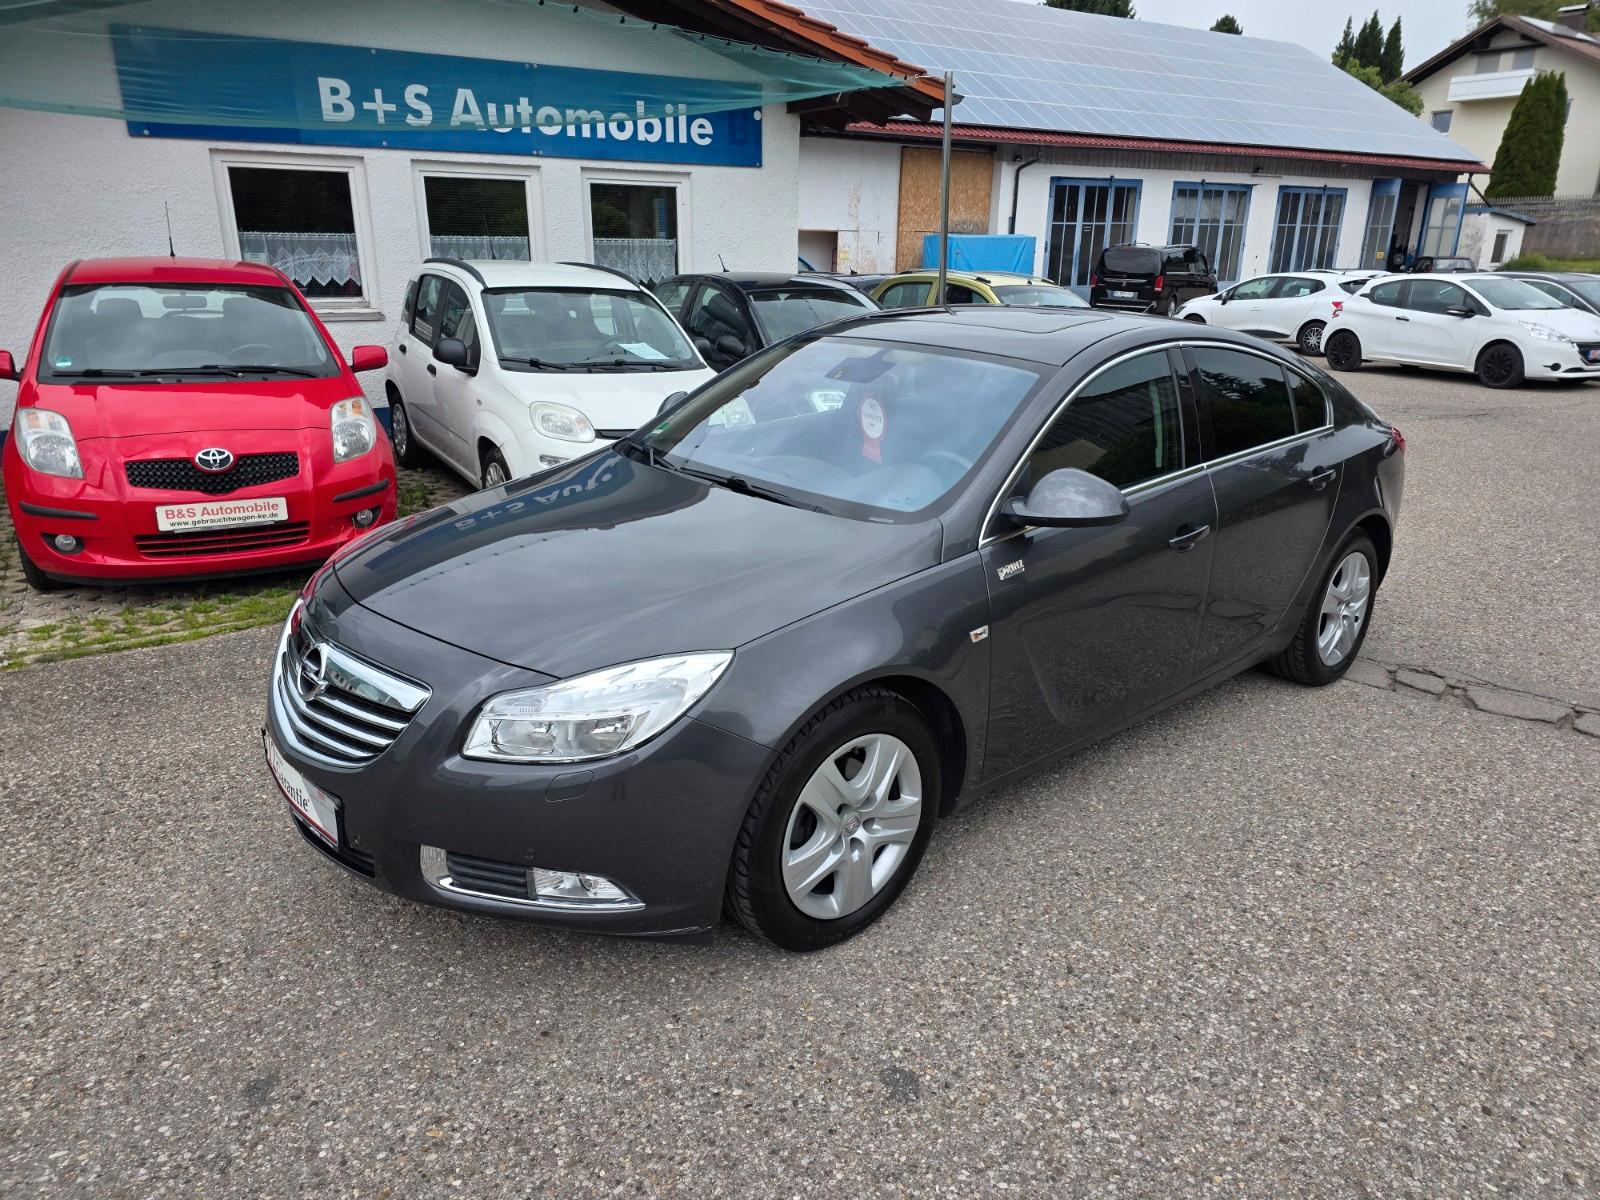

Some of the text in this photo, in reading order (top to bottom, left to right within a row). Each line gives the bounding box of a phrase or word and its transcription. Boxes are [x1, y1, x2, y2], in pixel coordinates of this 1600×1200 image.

[317, 76, 714, 146] B+S Automobile
[165, 502, 279, 519] B&S Automobile
[170, 512, 279, 527] www.gebrauchtwagen-ke.de
